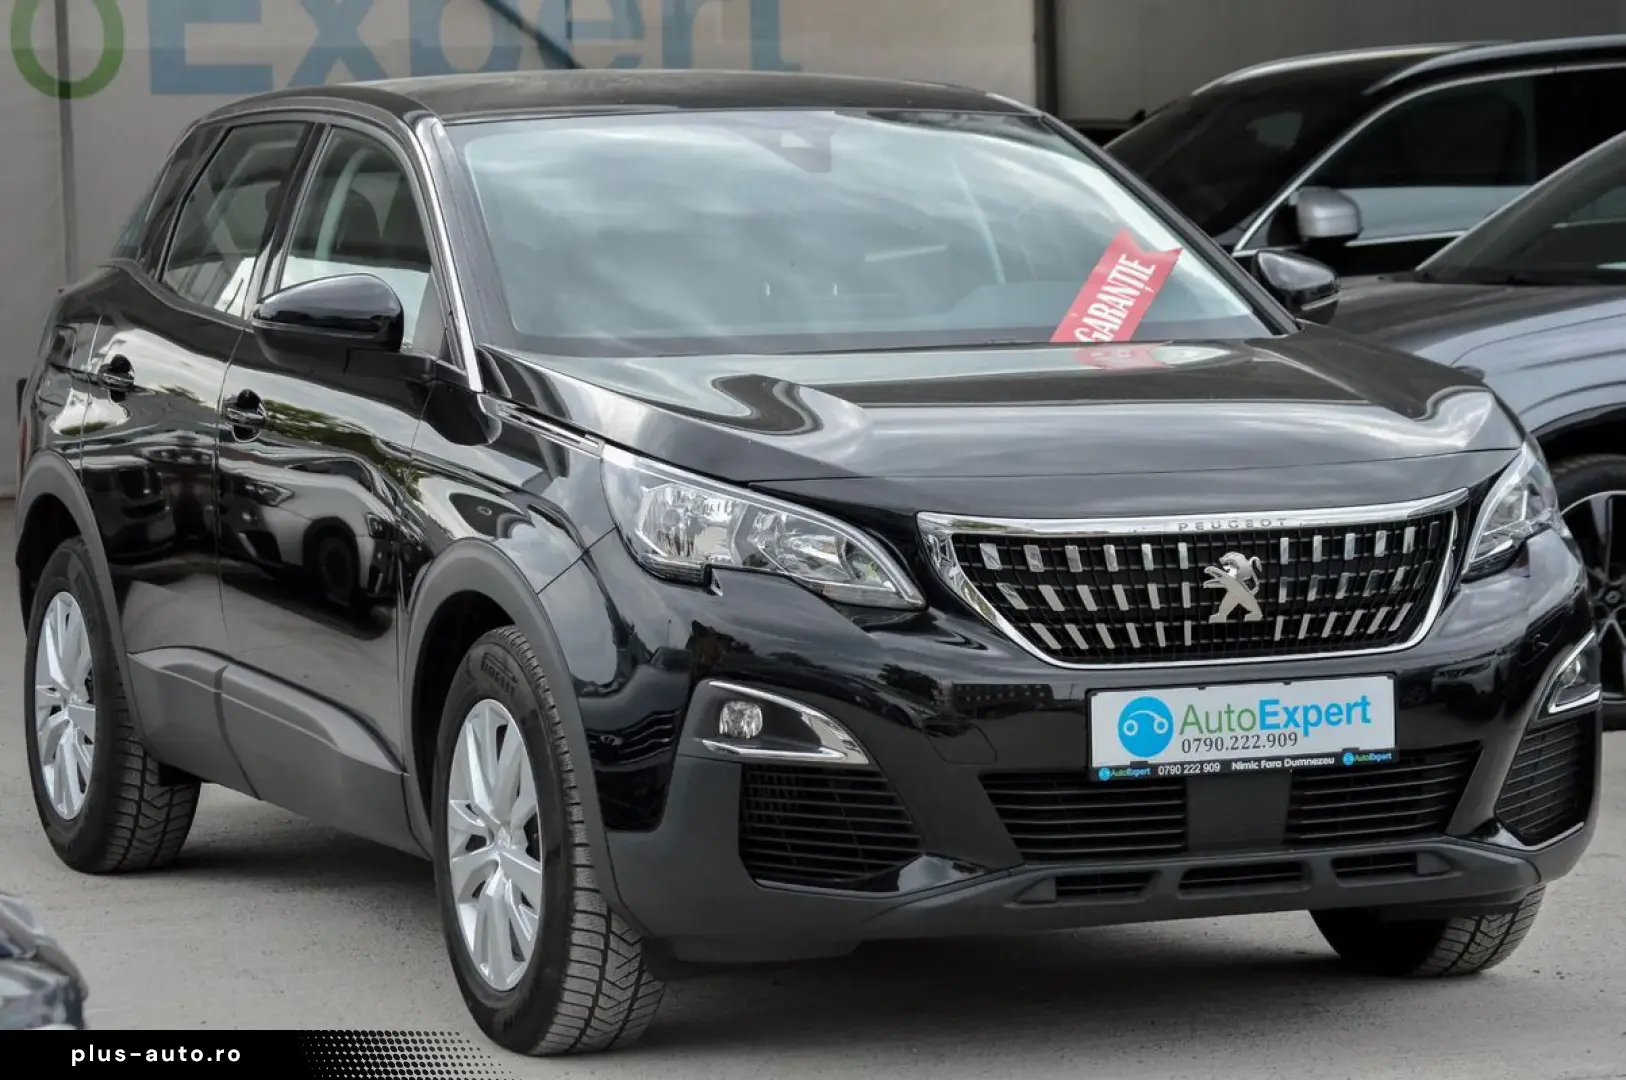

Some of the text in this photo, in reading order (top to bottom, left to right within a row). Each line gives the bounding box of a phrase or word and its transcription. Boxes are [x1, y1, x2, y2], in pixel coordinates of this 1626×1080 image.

[1178, 518, 1287, 532] PEUGEOT
[1179, 695, 1372, 737] AutoExpert
[1181, 731, 1298, 754] 0790.222.909
[1231, 756, 1335, 771] Nimic Fara Dumnezeu
[1355, 752, 1392, 763] AutoExpert
[1110, 767, 1151, 777] AutoExpert
[1157, 762, 1221, 775] 0790 222 909
